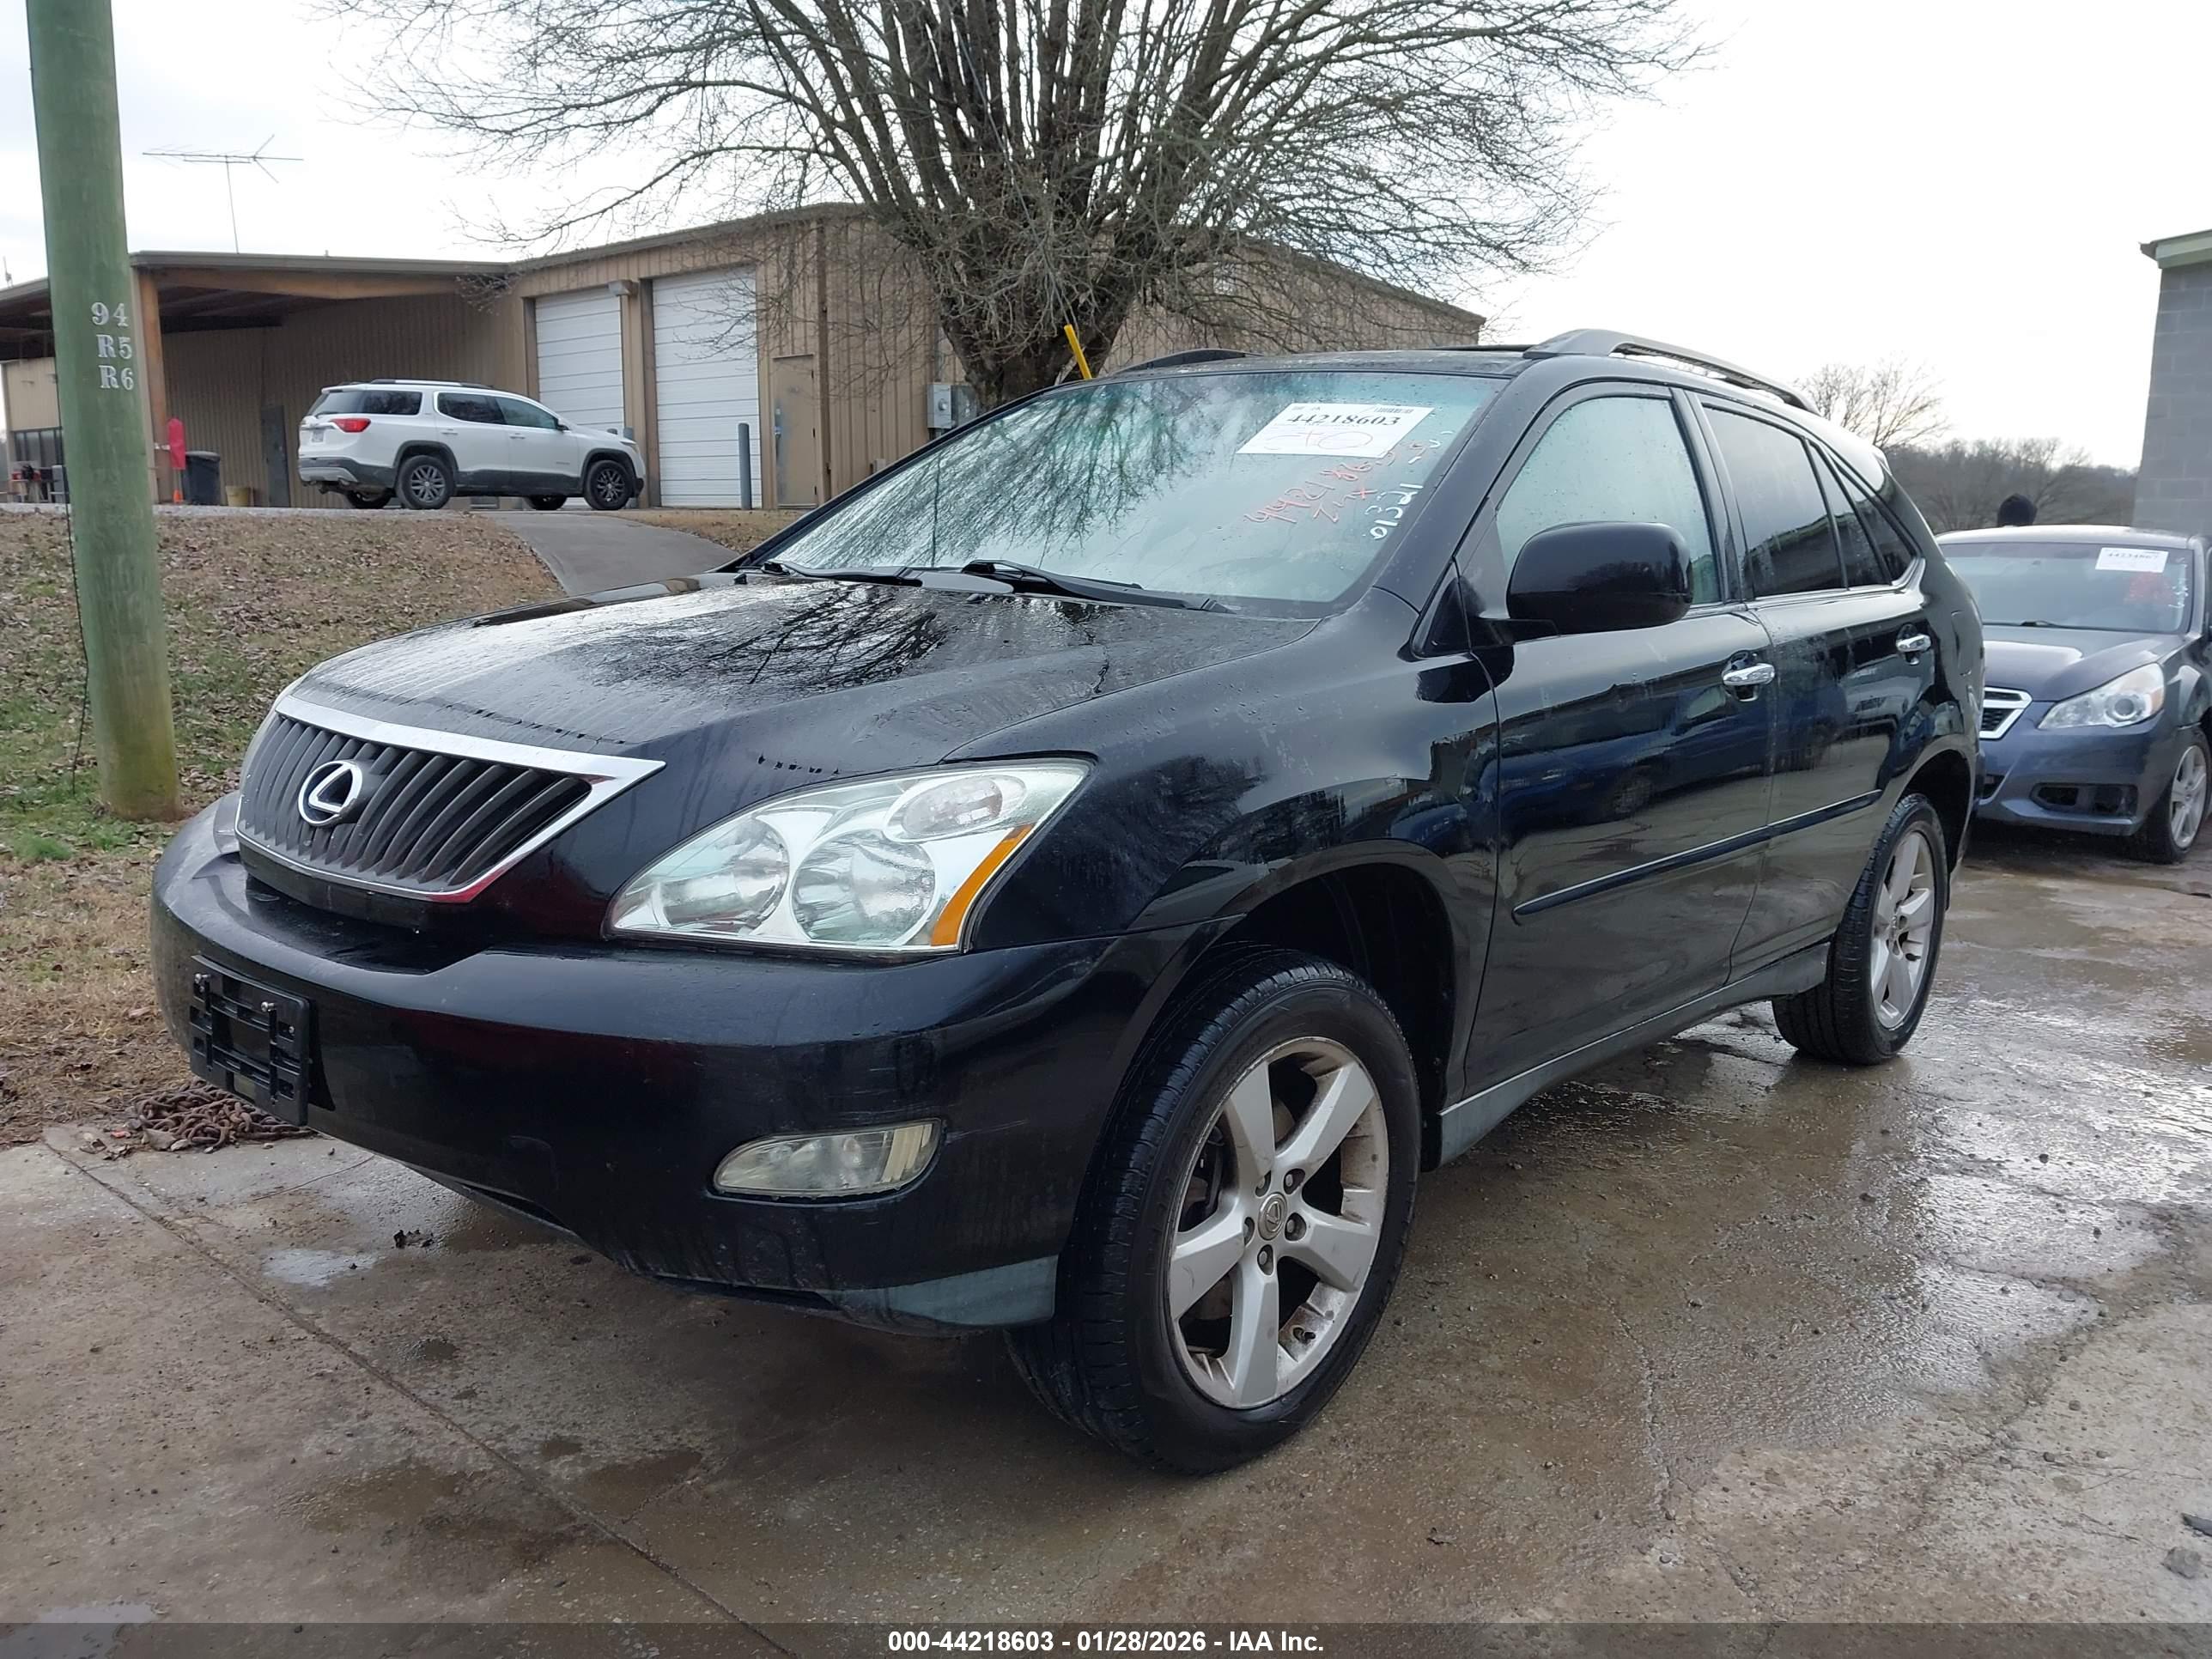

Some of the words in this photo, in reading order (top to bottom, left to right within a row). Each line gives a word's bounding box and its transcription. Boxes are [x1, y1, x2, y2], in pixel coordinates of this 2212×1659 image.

[91, 301, 129, 327] 94
[95, 334, 132, 359] R5
[98, 364, 134, 390] R6
[1286, 414, 1401, 426] 44218603
